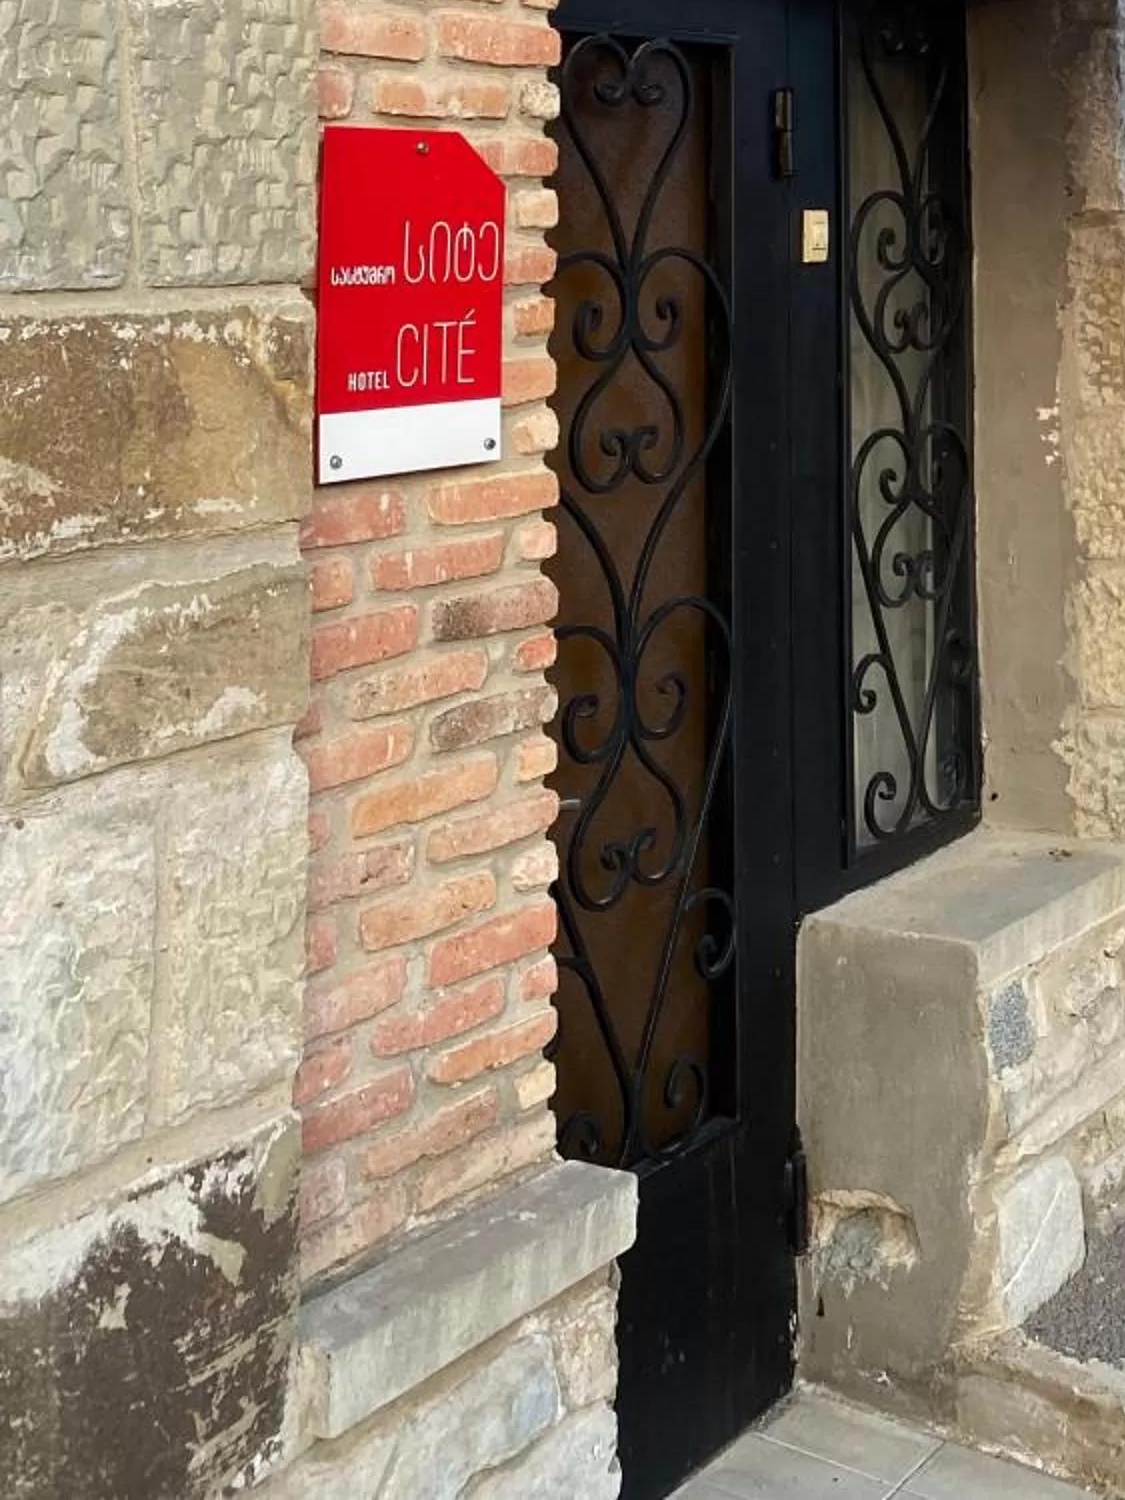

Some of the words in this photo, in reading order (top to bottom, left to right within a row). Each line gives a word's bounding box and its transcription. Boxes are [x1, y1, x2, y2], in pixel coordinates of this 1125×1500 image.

[403, 219, 500, 284] სიტე
[347, 369, 391, 393] HOTEL
[396, 308, 477, 388] CITÉ
